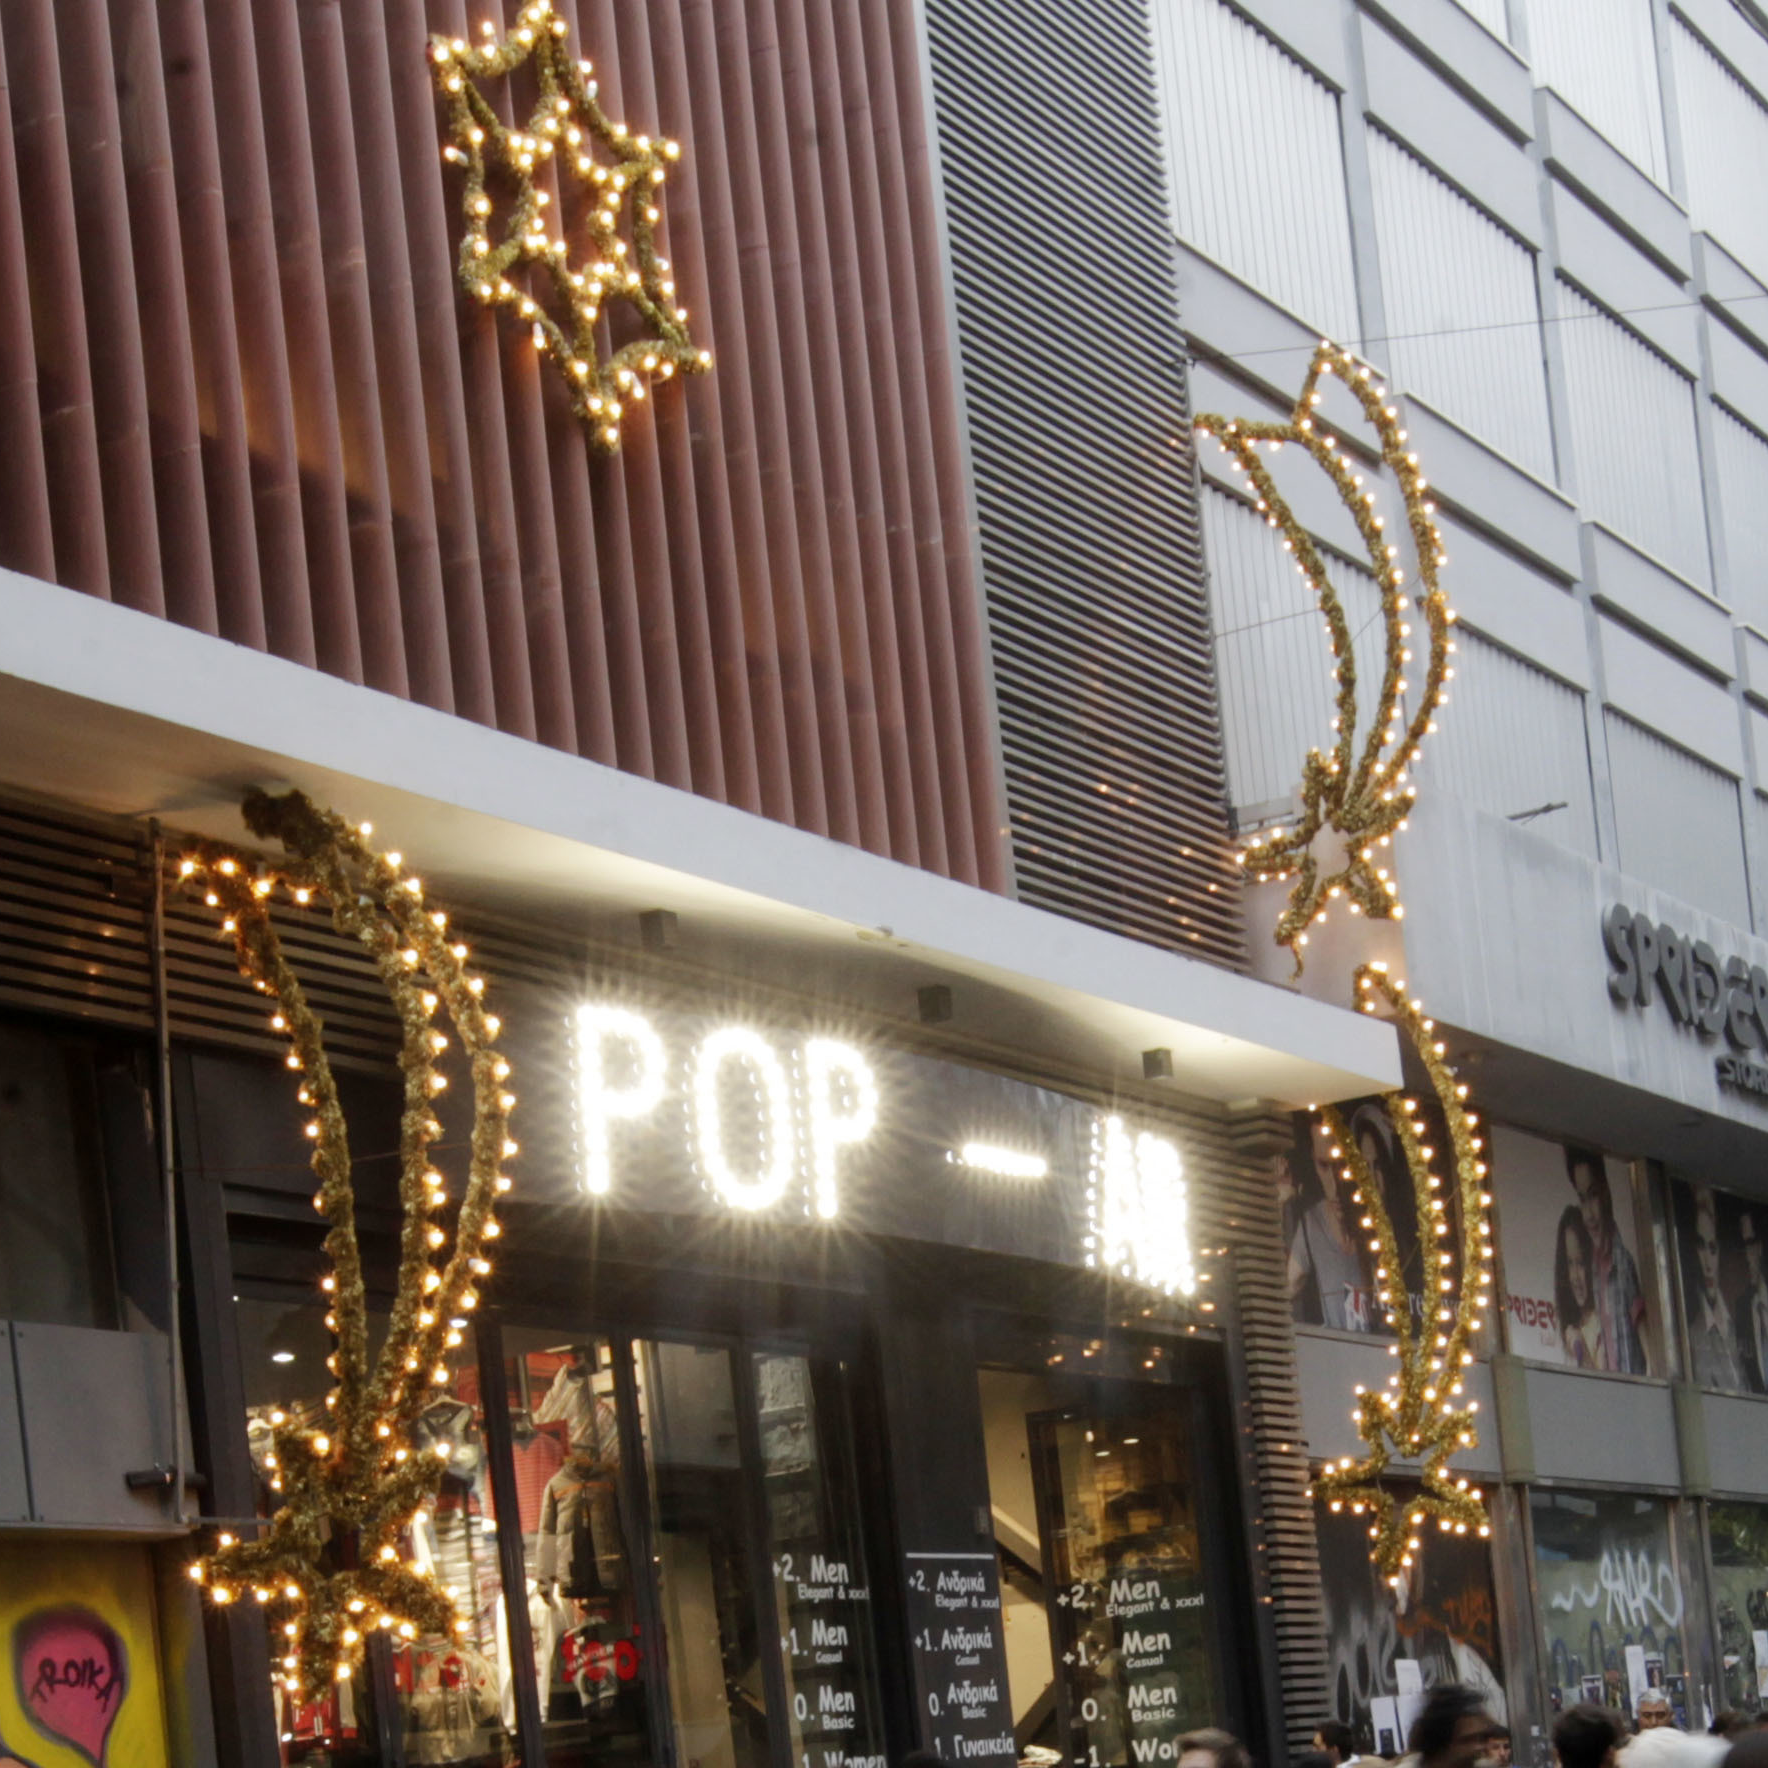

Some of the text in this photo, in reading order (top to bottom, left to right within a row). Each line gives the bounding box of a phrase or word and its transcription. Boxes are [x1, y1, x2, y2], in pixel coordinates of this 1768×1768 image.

[571, 1004, 878, 1219] POP
[810, 1554, 849, 1583] Men
[798, 1583, 834, 1604] Elegant
[837, 1585, 846, 1600] &
[936, 1569, 986, 1597] Ανδρικά
[1109, 1578, 1161, 1604] Men
[935, 1595, 968, 1612] Elegant
[971, 1596, 978, 1608] &
[1105, 1601, 1154, 1618] Elegant
[1160, 1597, 1171, 1611] &
[811, 1619, 848, 1648] Men
[941, 1625, 993, 1654] Ανδρικά
[1121, 1630, 1171, 1656] Men
[815, 1651, 844, 1665] Casual
[955, 1654, 981, 1667] Casual
[1126, 1654, 1164, 1669] Casual
[819, 1685, 856, 1714] Men
[947, 1678, 999, 1708] Ανδρικά
[1081, 1684, 1178, 1722] 0. Men
[822, 1713, 856, 1731] Basic
[962, 1704, 988, 1720] Basic
[1131, 1707, 1176, 1723] Basic
[953, 1730, 1016, 1760] Γυναικεία
